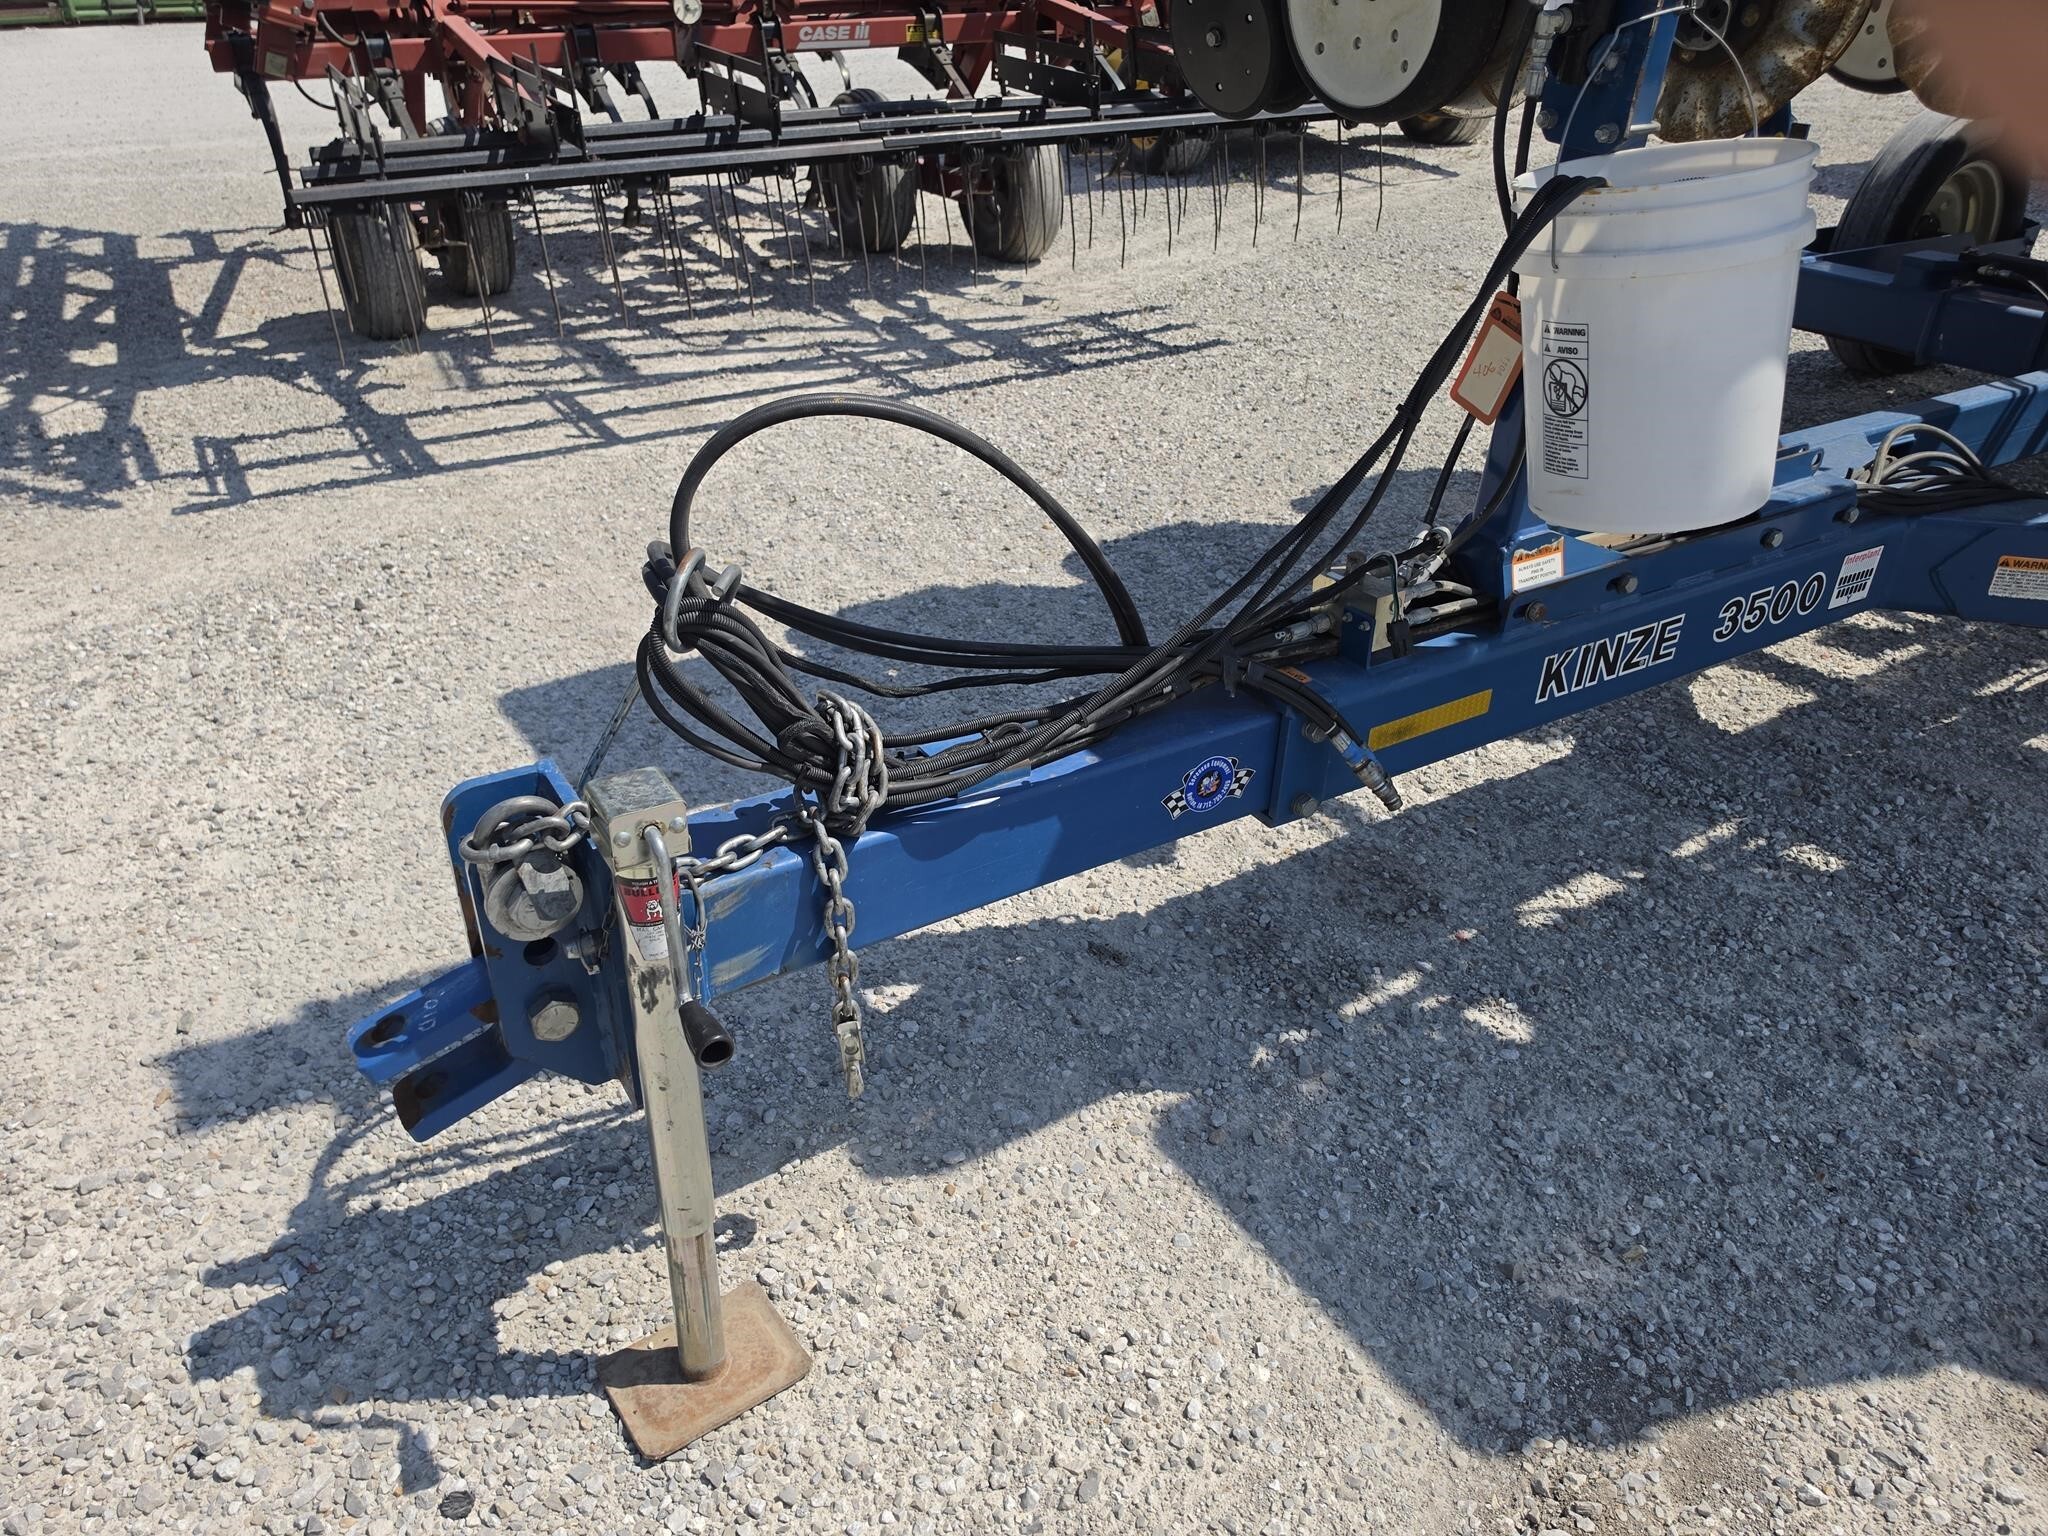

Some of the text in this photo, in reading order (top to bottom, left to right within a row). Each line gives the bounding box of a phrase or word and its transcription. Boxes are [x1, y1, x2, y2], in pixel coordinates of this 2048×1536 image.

[799, 25, 850, 41] CASE
[1553, 326, 1586, 337] WARNING
[1557, 346, 1579, 356] AVISO
[1535, 571, 1826, 704] KINZE 3500
